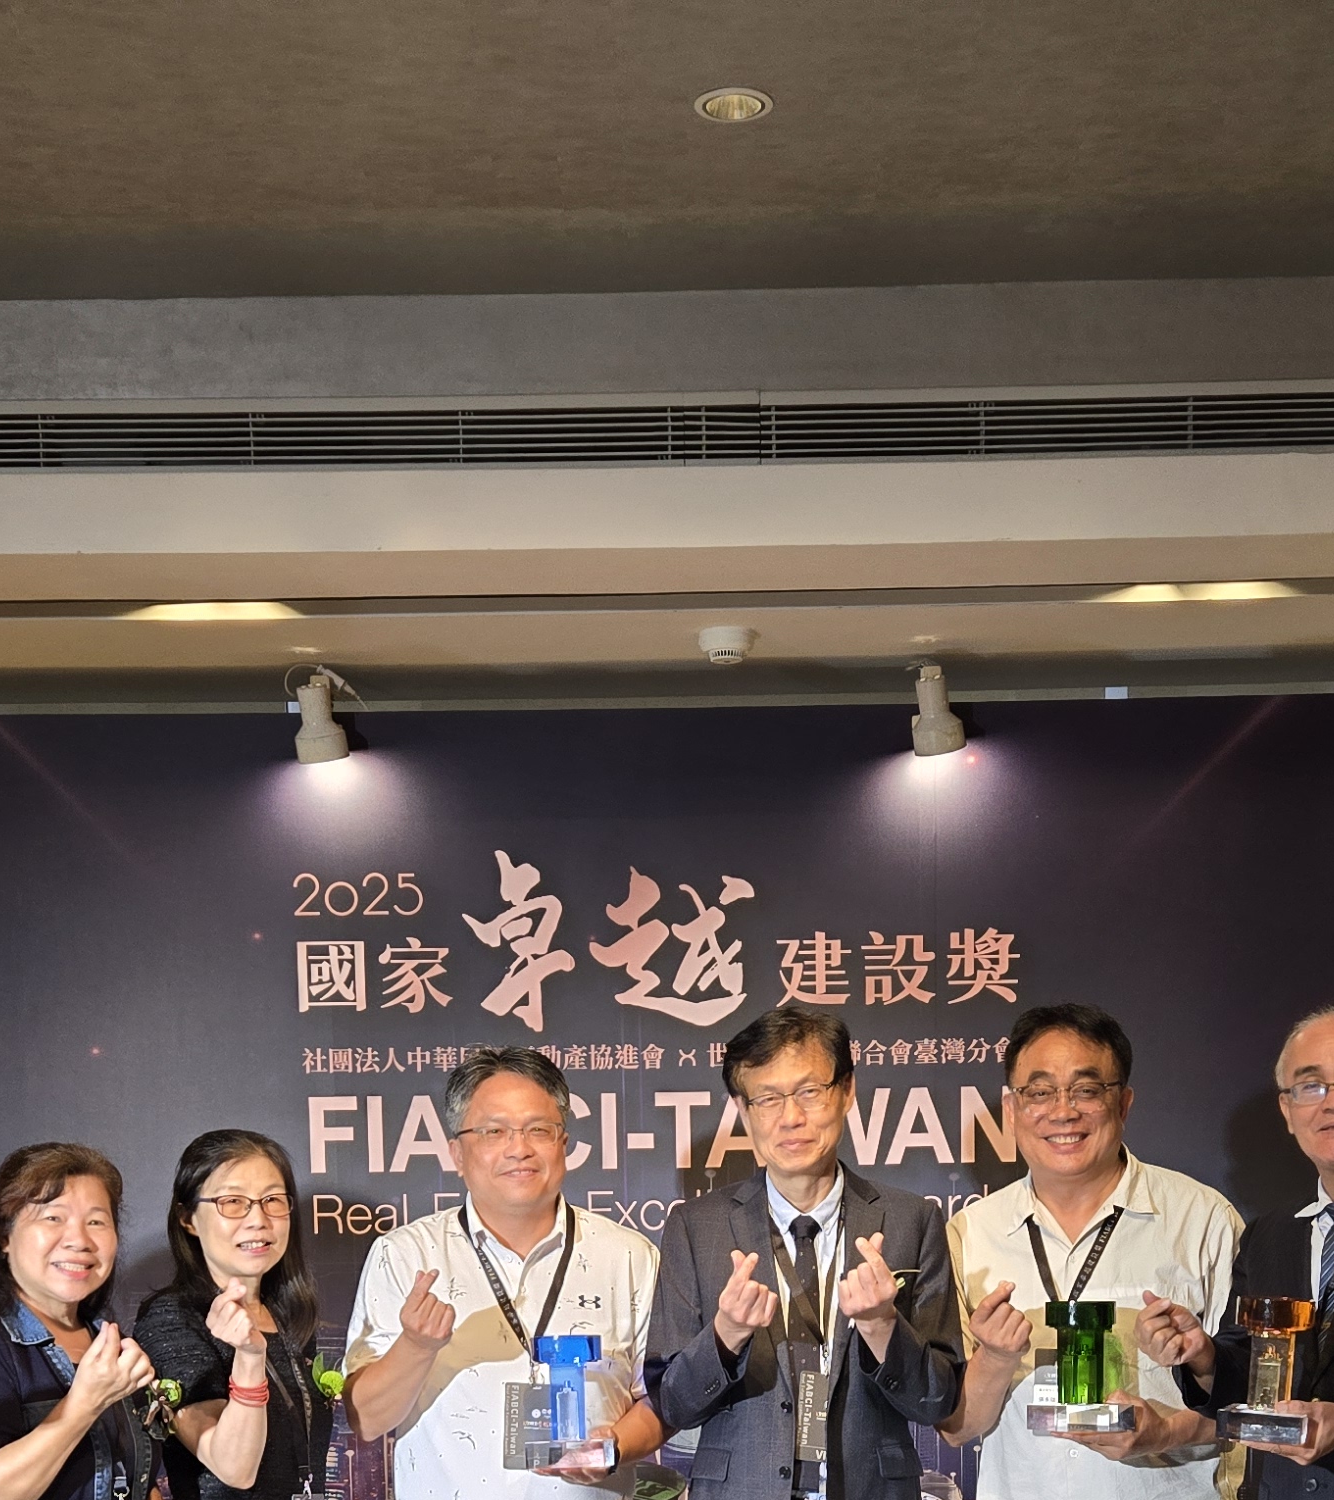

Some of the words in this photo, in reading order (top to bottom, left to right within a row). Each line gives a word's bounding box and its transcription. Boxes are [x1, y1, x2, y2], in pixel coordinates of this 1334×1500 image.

[292, 872, 424, 917] 2025
[302, 1043, 665, 1074] 社團法人中華動產協進會
[308, 1085, 1017, 1174] FIACI-TAWAN
[312, 1194, 408, 1235] Real
[510, 1385, 519, 1455] FIABCI-Taiwan
[801, 1374, 815, 1445] FIABCI-Taiwan
[815, 1449, 827, 1461] VI
